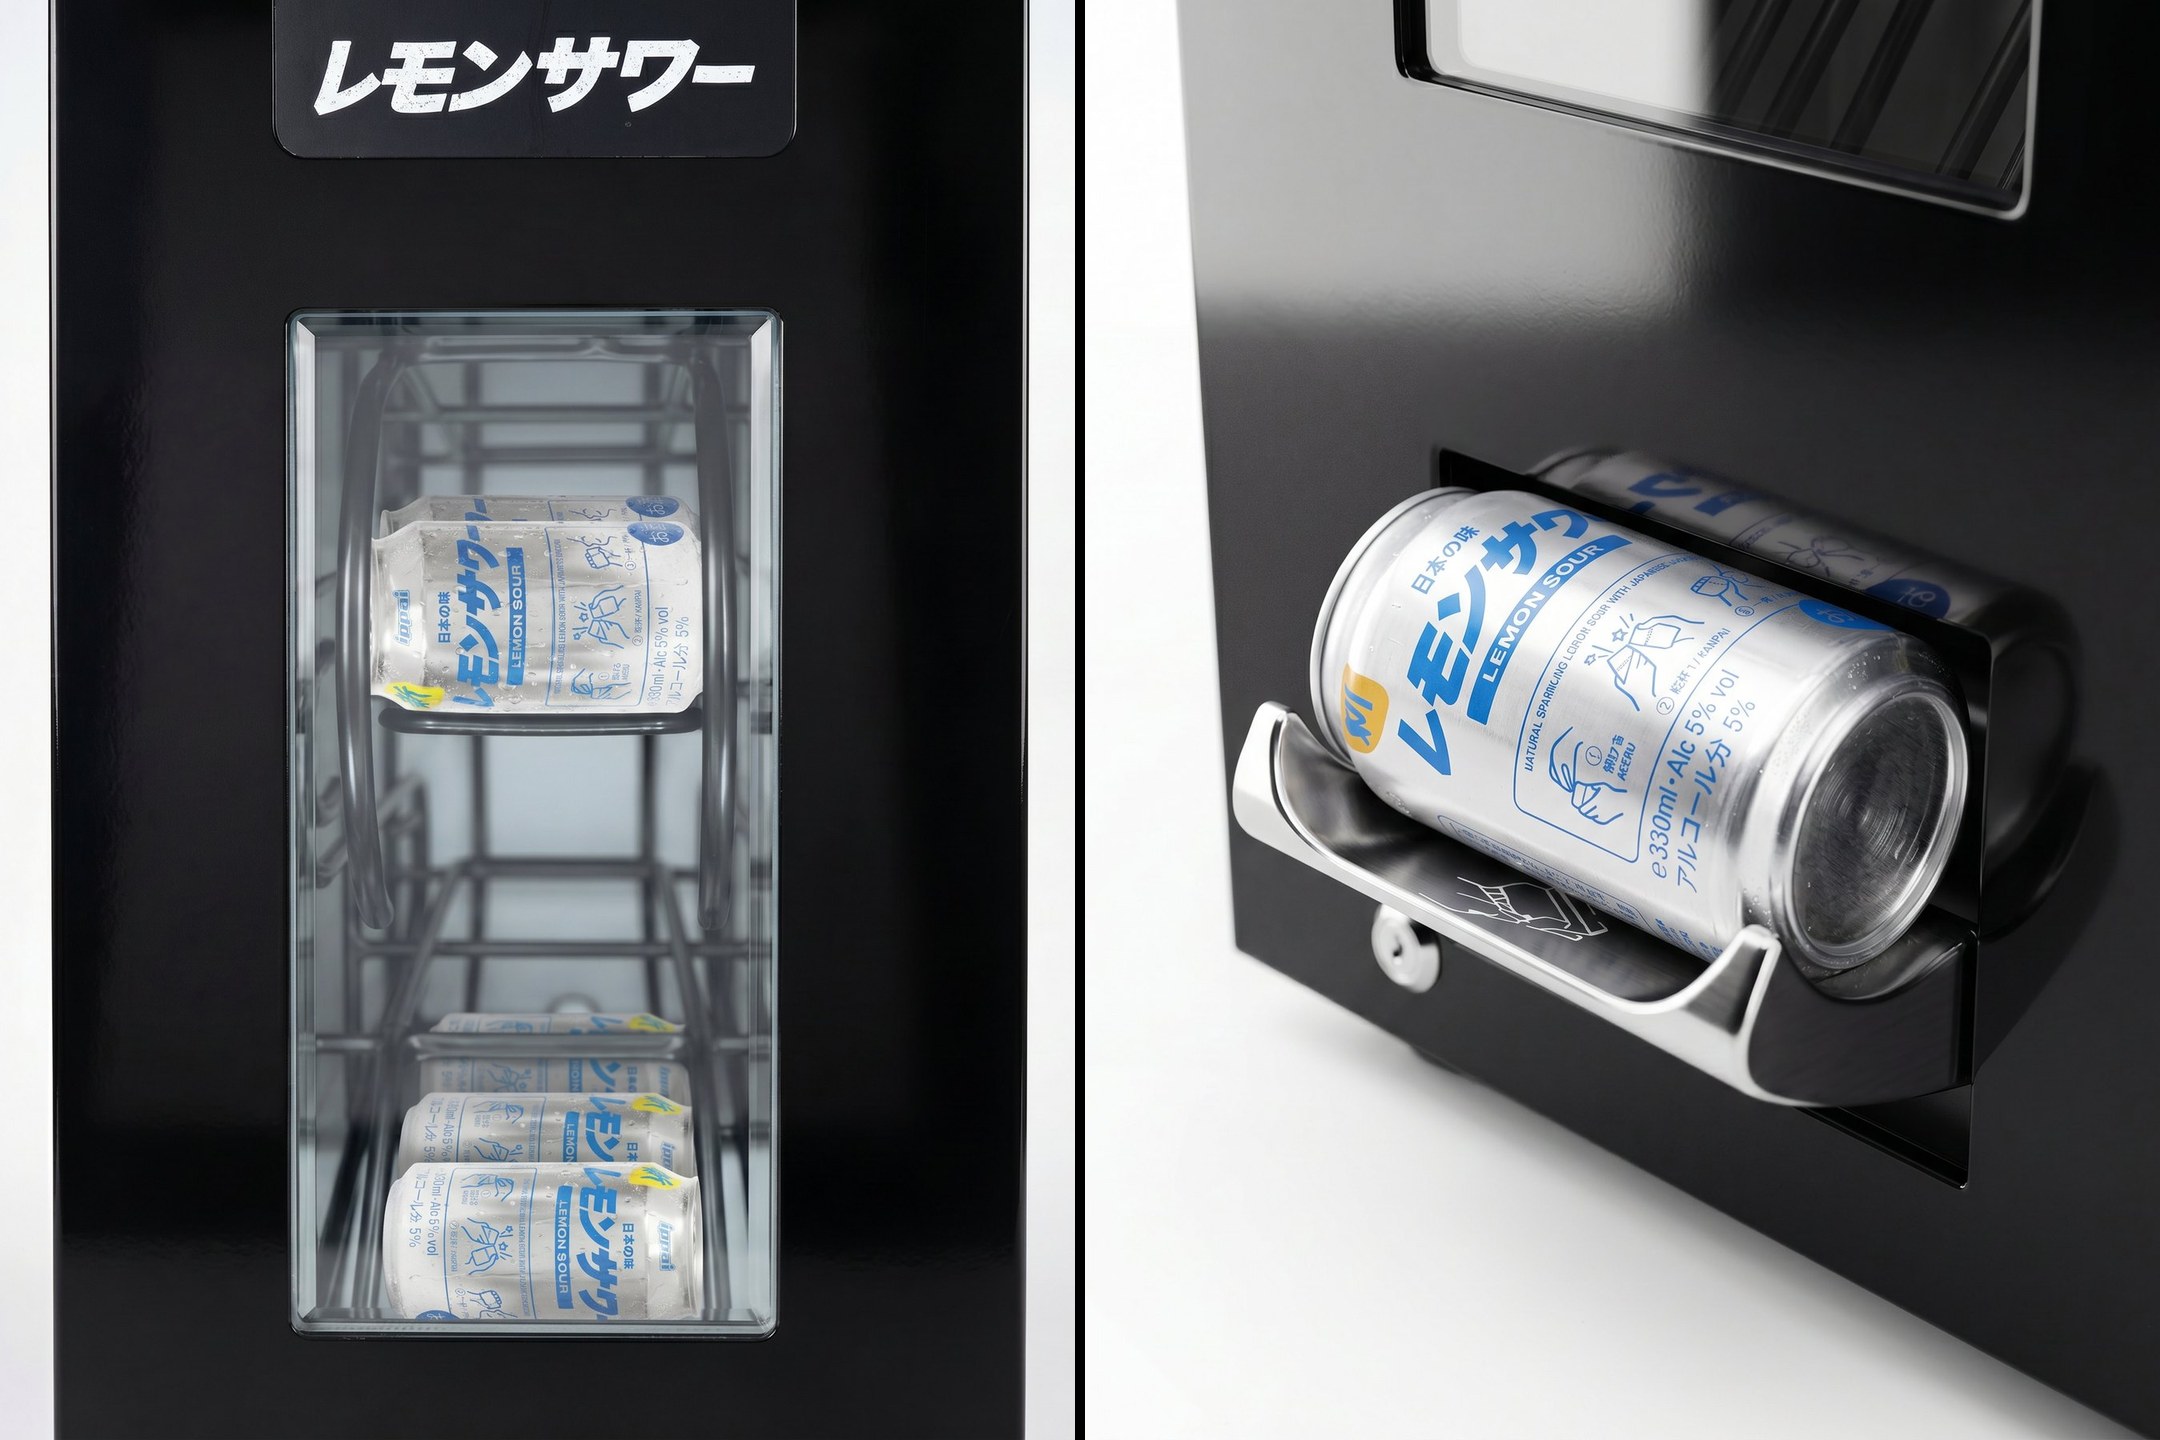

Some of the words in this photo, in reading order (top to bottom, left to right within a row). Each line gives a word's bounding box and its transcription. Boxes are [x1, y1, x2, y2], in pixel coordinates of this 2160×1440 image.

[313, 36, 756, 116] レモンサワー
[1411, 525, 1480, 594] 日本の味
[511, 565, 523, 607] SOUR
[1606, 585, 1630, 606] WITH
[392, 590, 412, 646] ippai
[438, 591, 451, 644] 日本の味
[453, 525, 501, 708] レモンサワー
[654, 607, 669, 625] vol
[654, 627, 669, 647] 5%
[675, 616, 688, 637] 5%
[1482, 591, 1546, 683] LEMON
[1543, 544, 1604, 589] SOUR
[511, 610, 523, 668] LEMON
[1398, 509, 1606, 776] レモンサワ
[1685, 702, 1717, 736] 5%
[1710, 669, 1741, 697] vol
[1677, 739, 1732, 893] アルコール分
[1723, 700, 1757, 732] 5%
[564, 1123, 575, 1162] LEMON
[408, 1227, 421, 1247] 5%
[426, 1240, 439, 1255] vol
[427, 1218, 440, 1238] 5%
[557, 1200, 568, 1249] LEMON
[575, 1167, 624, 1320] レモンサワ
[622, 1223, 635, 1270] 日本の味
[658, 1221, 676, 1271] ippai
[557, 1252, 568, 1294] SOUR
